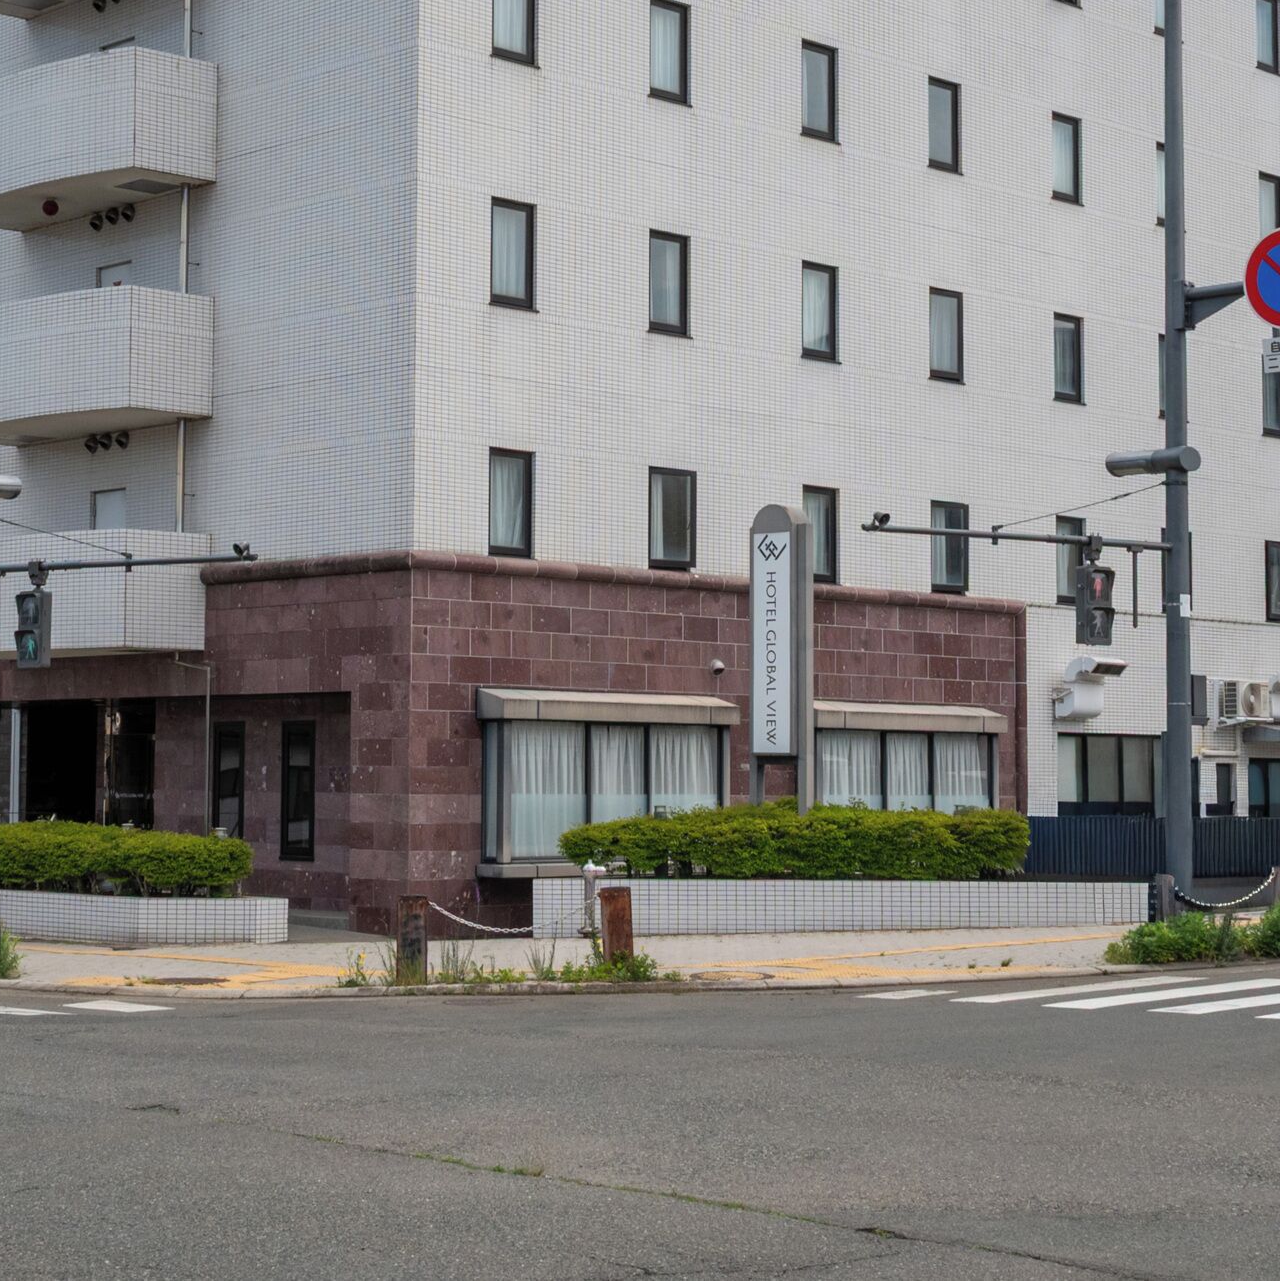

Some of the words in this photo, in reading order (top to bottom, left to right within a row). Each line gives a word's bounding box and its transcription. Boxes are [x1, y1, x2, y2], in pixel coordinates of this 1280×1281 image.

[765, 571, 777, 621] HOTEL
[765, 629, 777, 696] GLOBAL
[765, 700, 777, 746] VIEW
